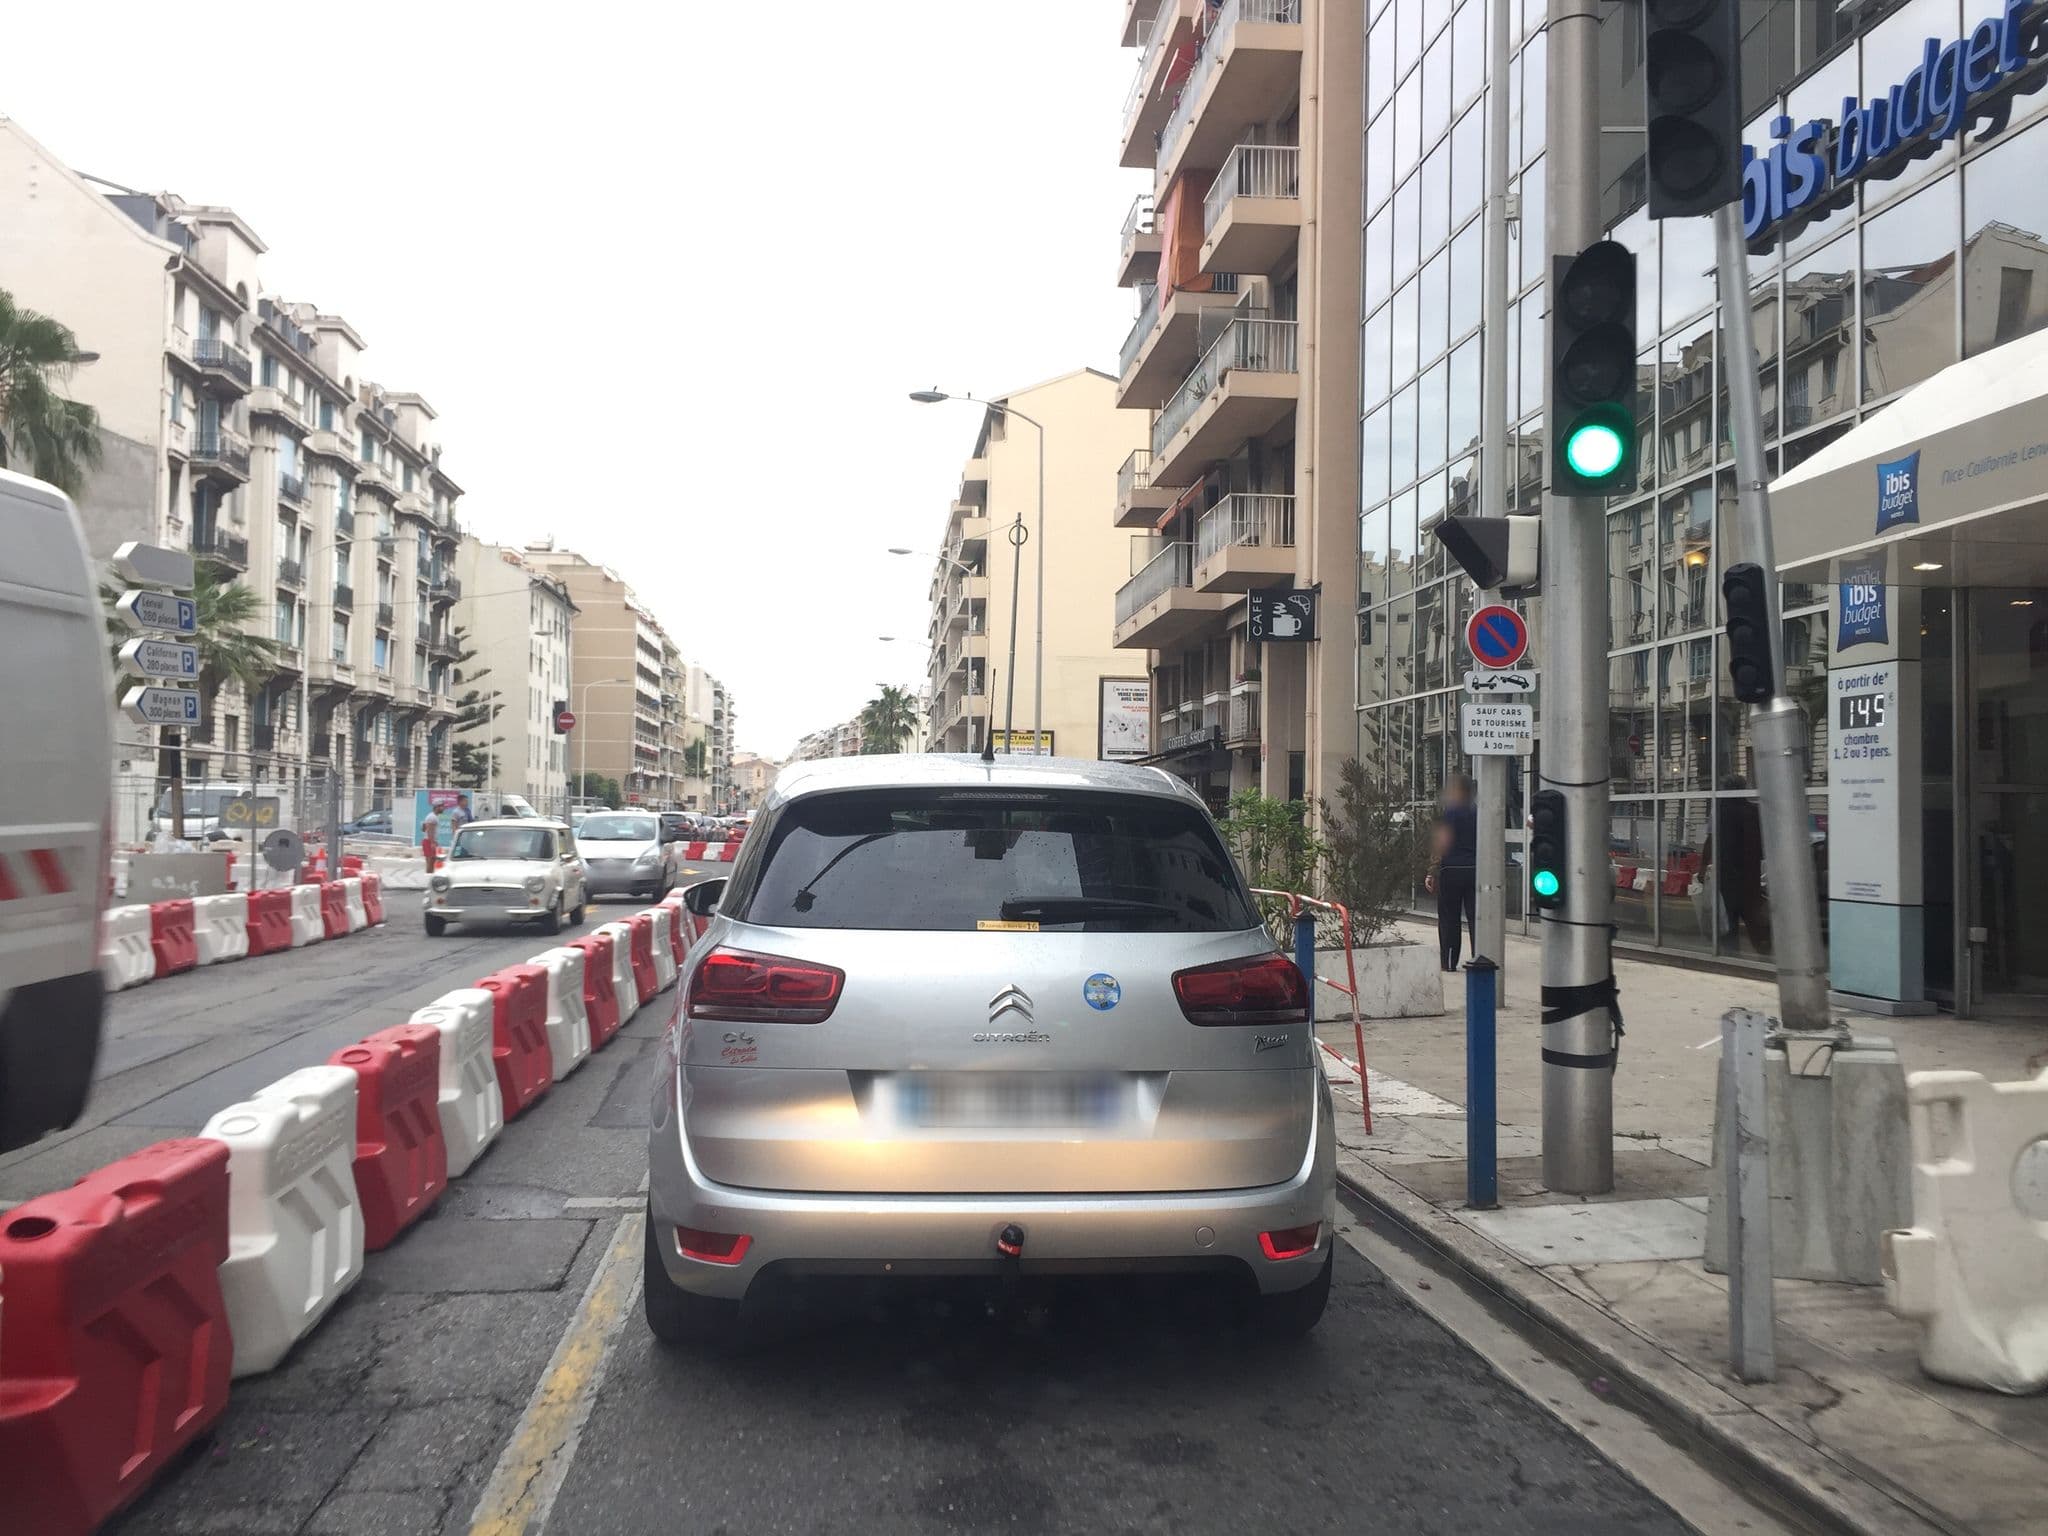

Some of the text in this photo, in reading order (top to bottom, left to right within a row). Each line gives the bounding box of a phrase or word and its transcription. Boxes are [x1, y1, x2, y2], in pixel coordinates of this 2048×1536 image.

[1739, 0, 2031, 240] bis budget
[1886, 470, 1911, 495] ibis
[1882, 489, 1914, 511] budget
[1849, 585, 1877, 606] ibis
[1252, 596, 1263, 637] CAFE
[1845, 602, 1882, 625] budget
[1845, 674, 1870, 692] partir
[1850, 694, 1884, 727] 145
[1168, 735, 1187, 749] COFFEE
[1468, 730, 1494, 738] DURÉE
[1844, 732, 1879, 746] chambre
[1843, 747, 1848, 759] 2
[1850, 750, 1860, 758] ou
[1863, 746, 1868, 758] 3
